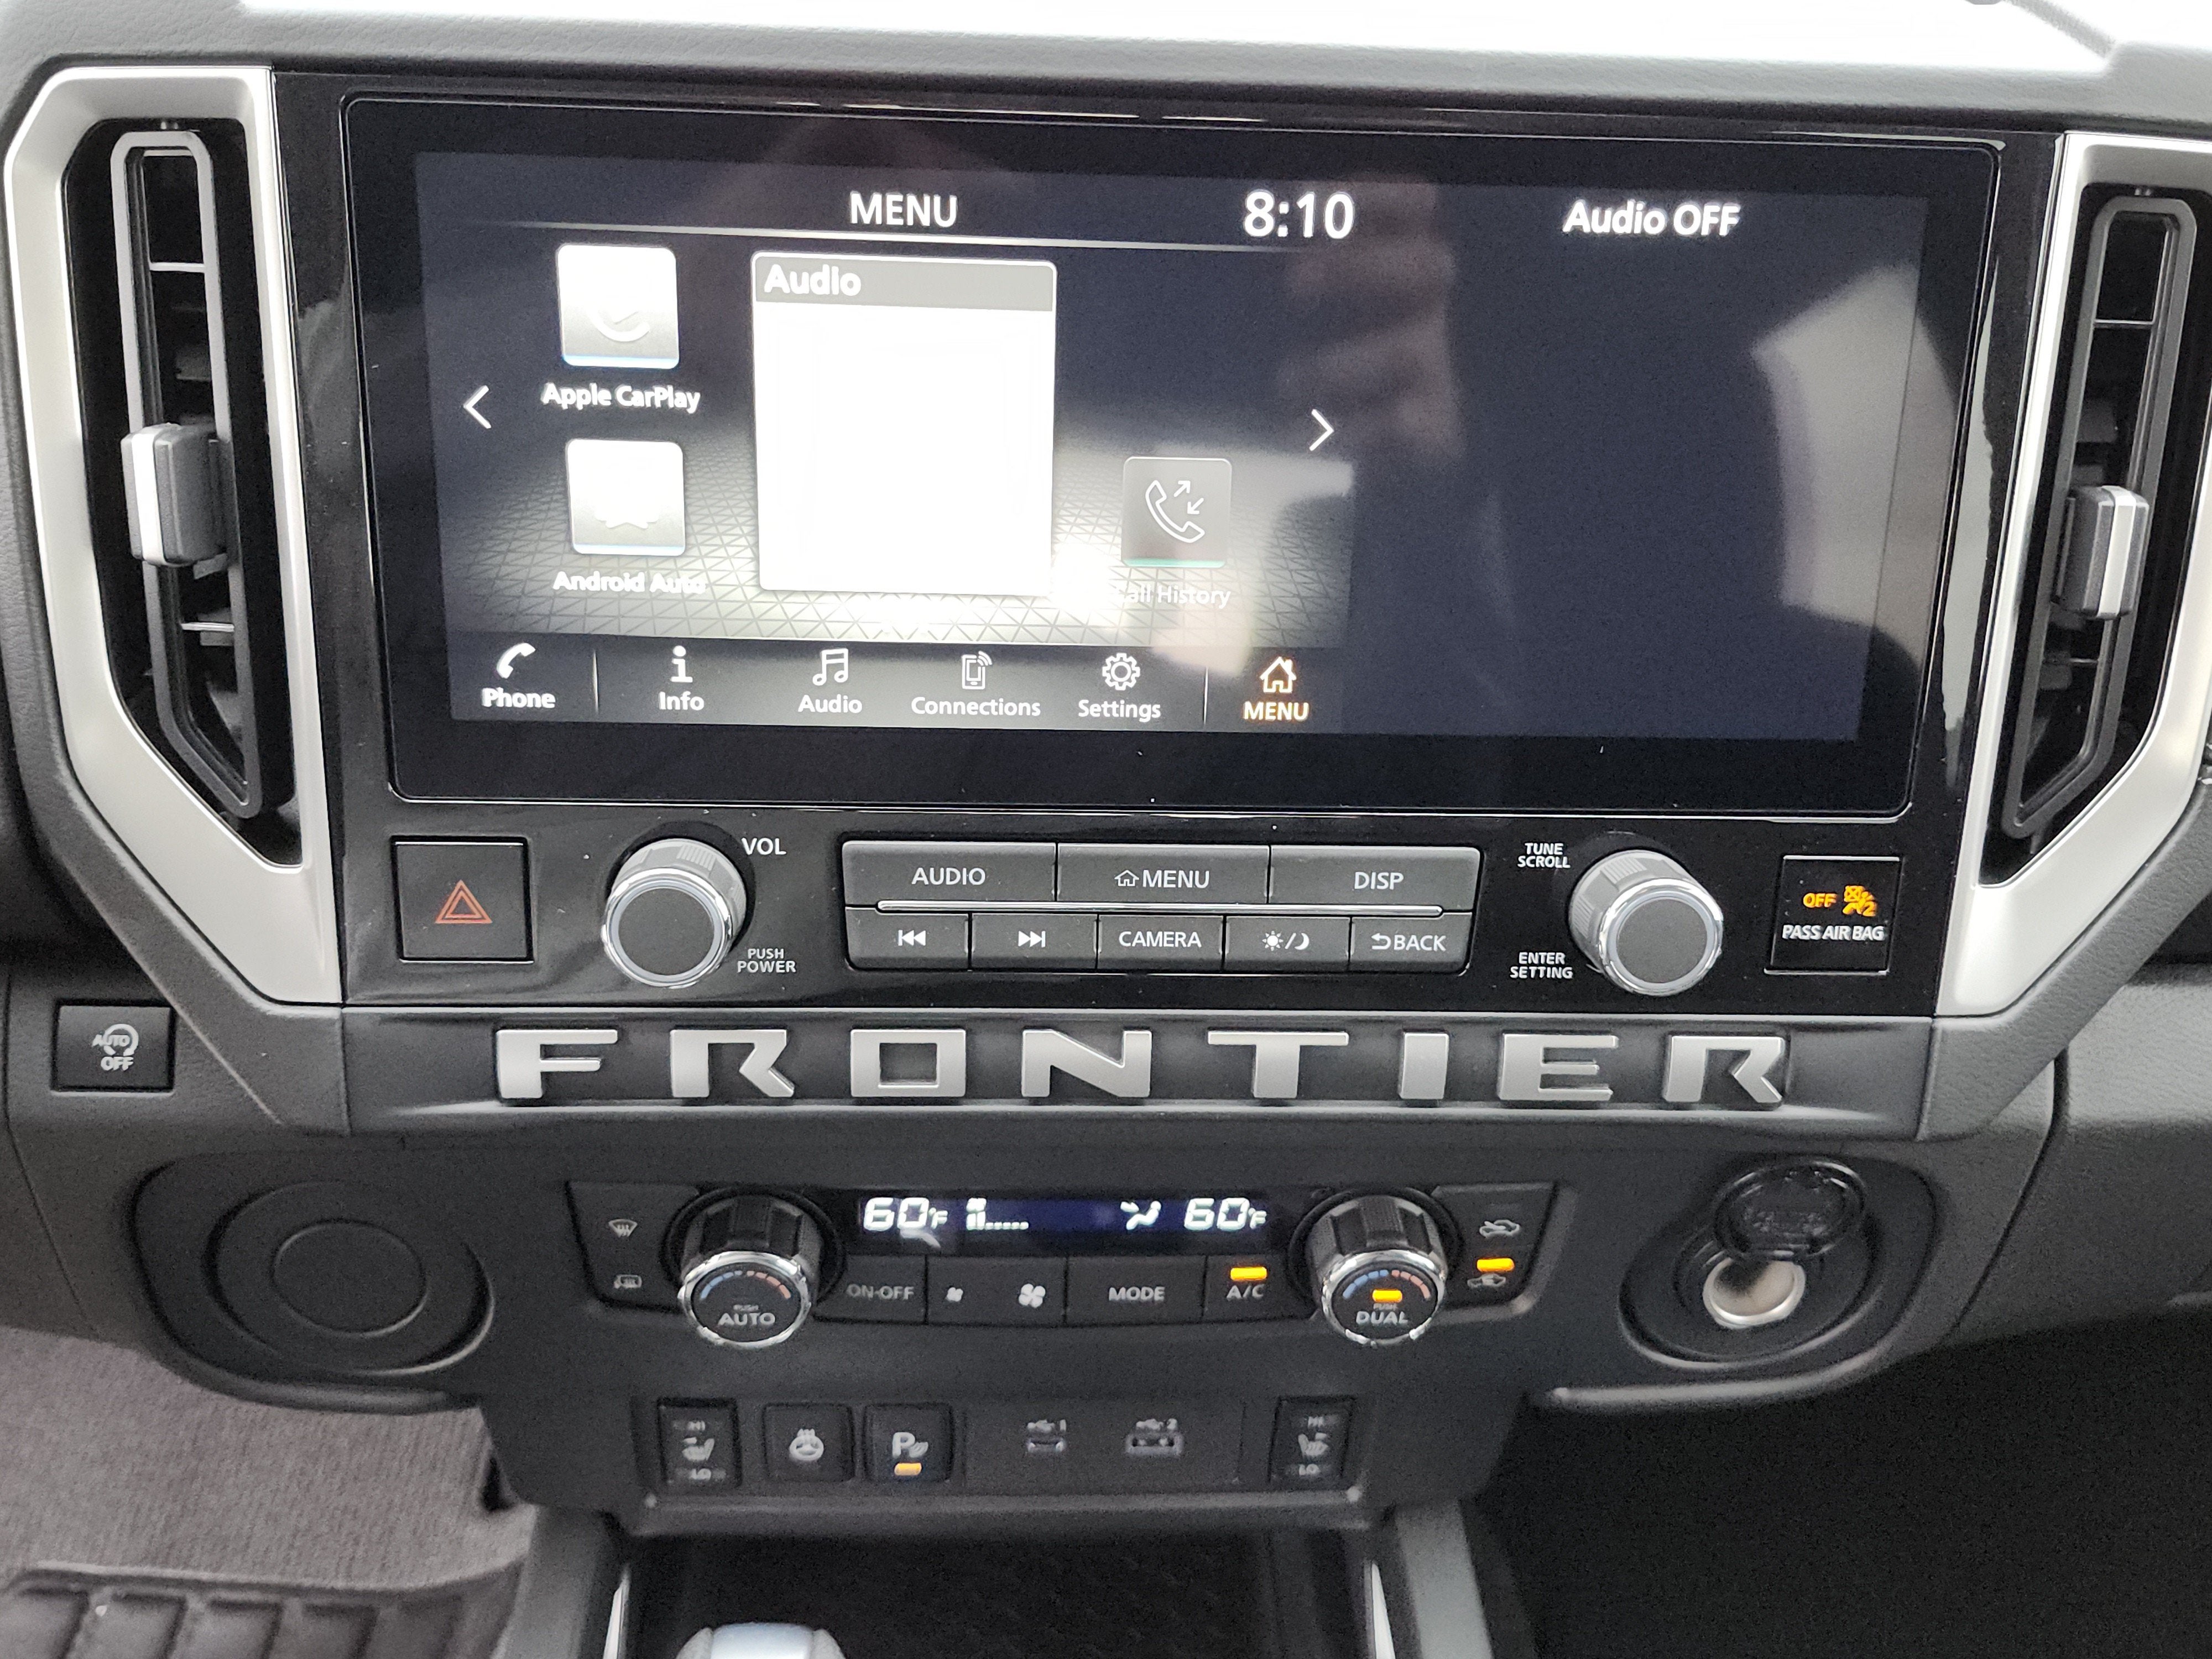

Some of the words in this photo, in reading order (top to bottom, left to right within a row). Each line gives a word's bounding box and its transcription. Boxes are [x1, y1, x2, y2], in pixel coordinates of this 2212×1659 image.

[849, 191, 958, 228] MENU
[1242, 190, 1355, 239] 8:10
[1562, 199, 1666, 235] Audio
[1672, 201, 1741, 237] OFF
[764, 263, 862, 297] Audio
[541, 383, 612, 409] Apple
[615, 385, 700, 414] CarPlay
[552, 571, 645, 592] Android
[649, 573, 707, 594] Auto
[1157, 585, 1231, 609] History
[482, 687, 556, 709] Phone
[659, 691, 705, 711] Info
[798, 694, 863, 714] Audio
[911, 696, 1041, 717] Connections
[1078, 700, 1161, 722] Settings
[1243, 702, 1309, 721] MENU
[742, 838, 786, 857] VOL
[1525, 842, 1563, 855] TUNE
[1517, 855, 1571, 869] SCROLL
[912, 868, 986, 886] AUDIO
[1142, 870, 1210, 889] MENU
[1354, 872, 1403, 890] DISP
[1803, 893, 1837, 908] OFF
[1119, 931, 1201, 948] CAMERA
[1782, 925, 1821, 940] PASS
[1822, 925, 1851, 940] AIR
[1853, 926, 1884, 941] BAG
[1394, 935, 1446, 951] BACK
[748, 948, 784, 959] PUSH
[1519, 952, 1566, 965] ENTER
[737, 961, 796, 973] POWER
[1510, 965, 1573, 978] SETTING
[101, 1056, 134, 1071] OFF
[497, 1027, 1786, 1106] FRONTIER
[847, 1284, 914, 1300] ON-OFF
[1109, 1286, 1165, 1302] MODE
[1227, 1284, 1265, 1300] A/C
[718, 1312, 775, 1326] AUTO
[1356, 1311, 1408, 1324] DUAL
